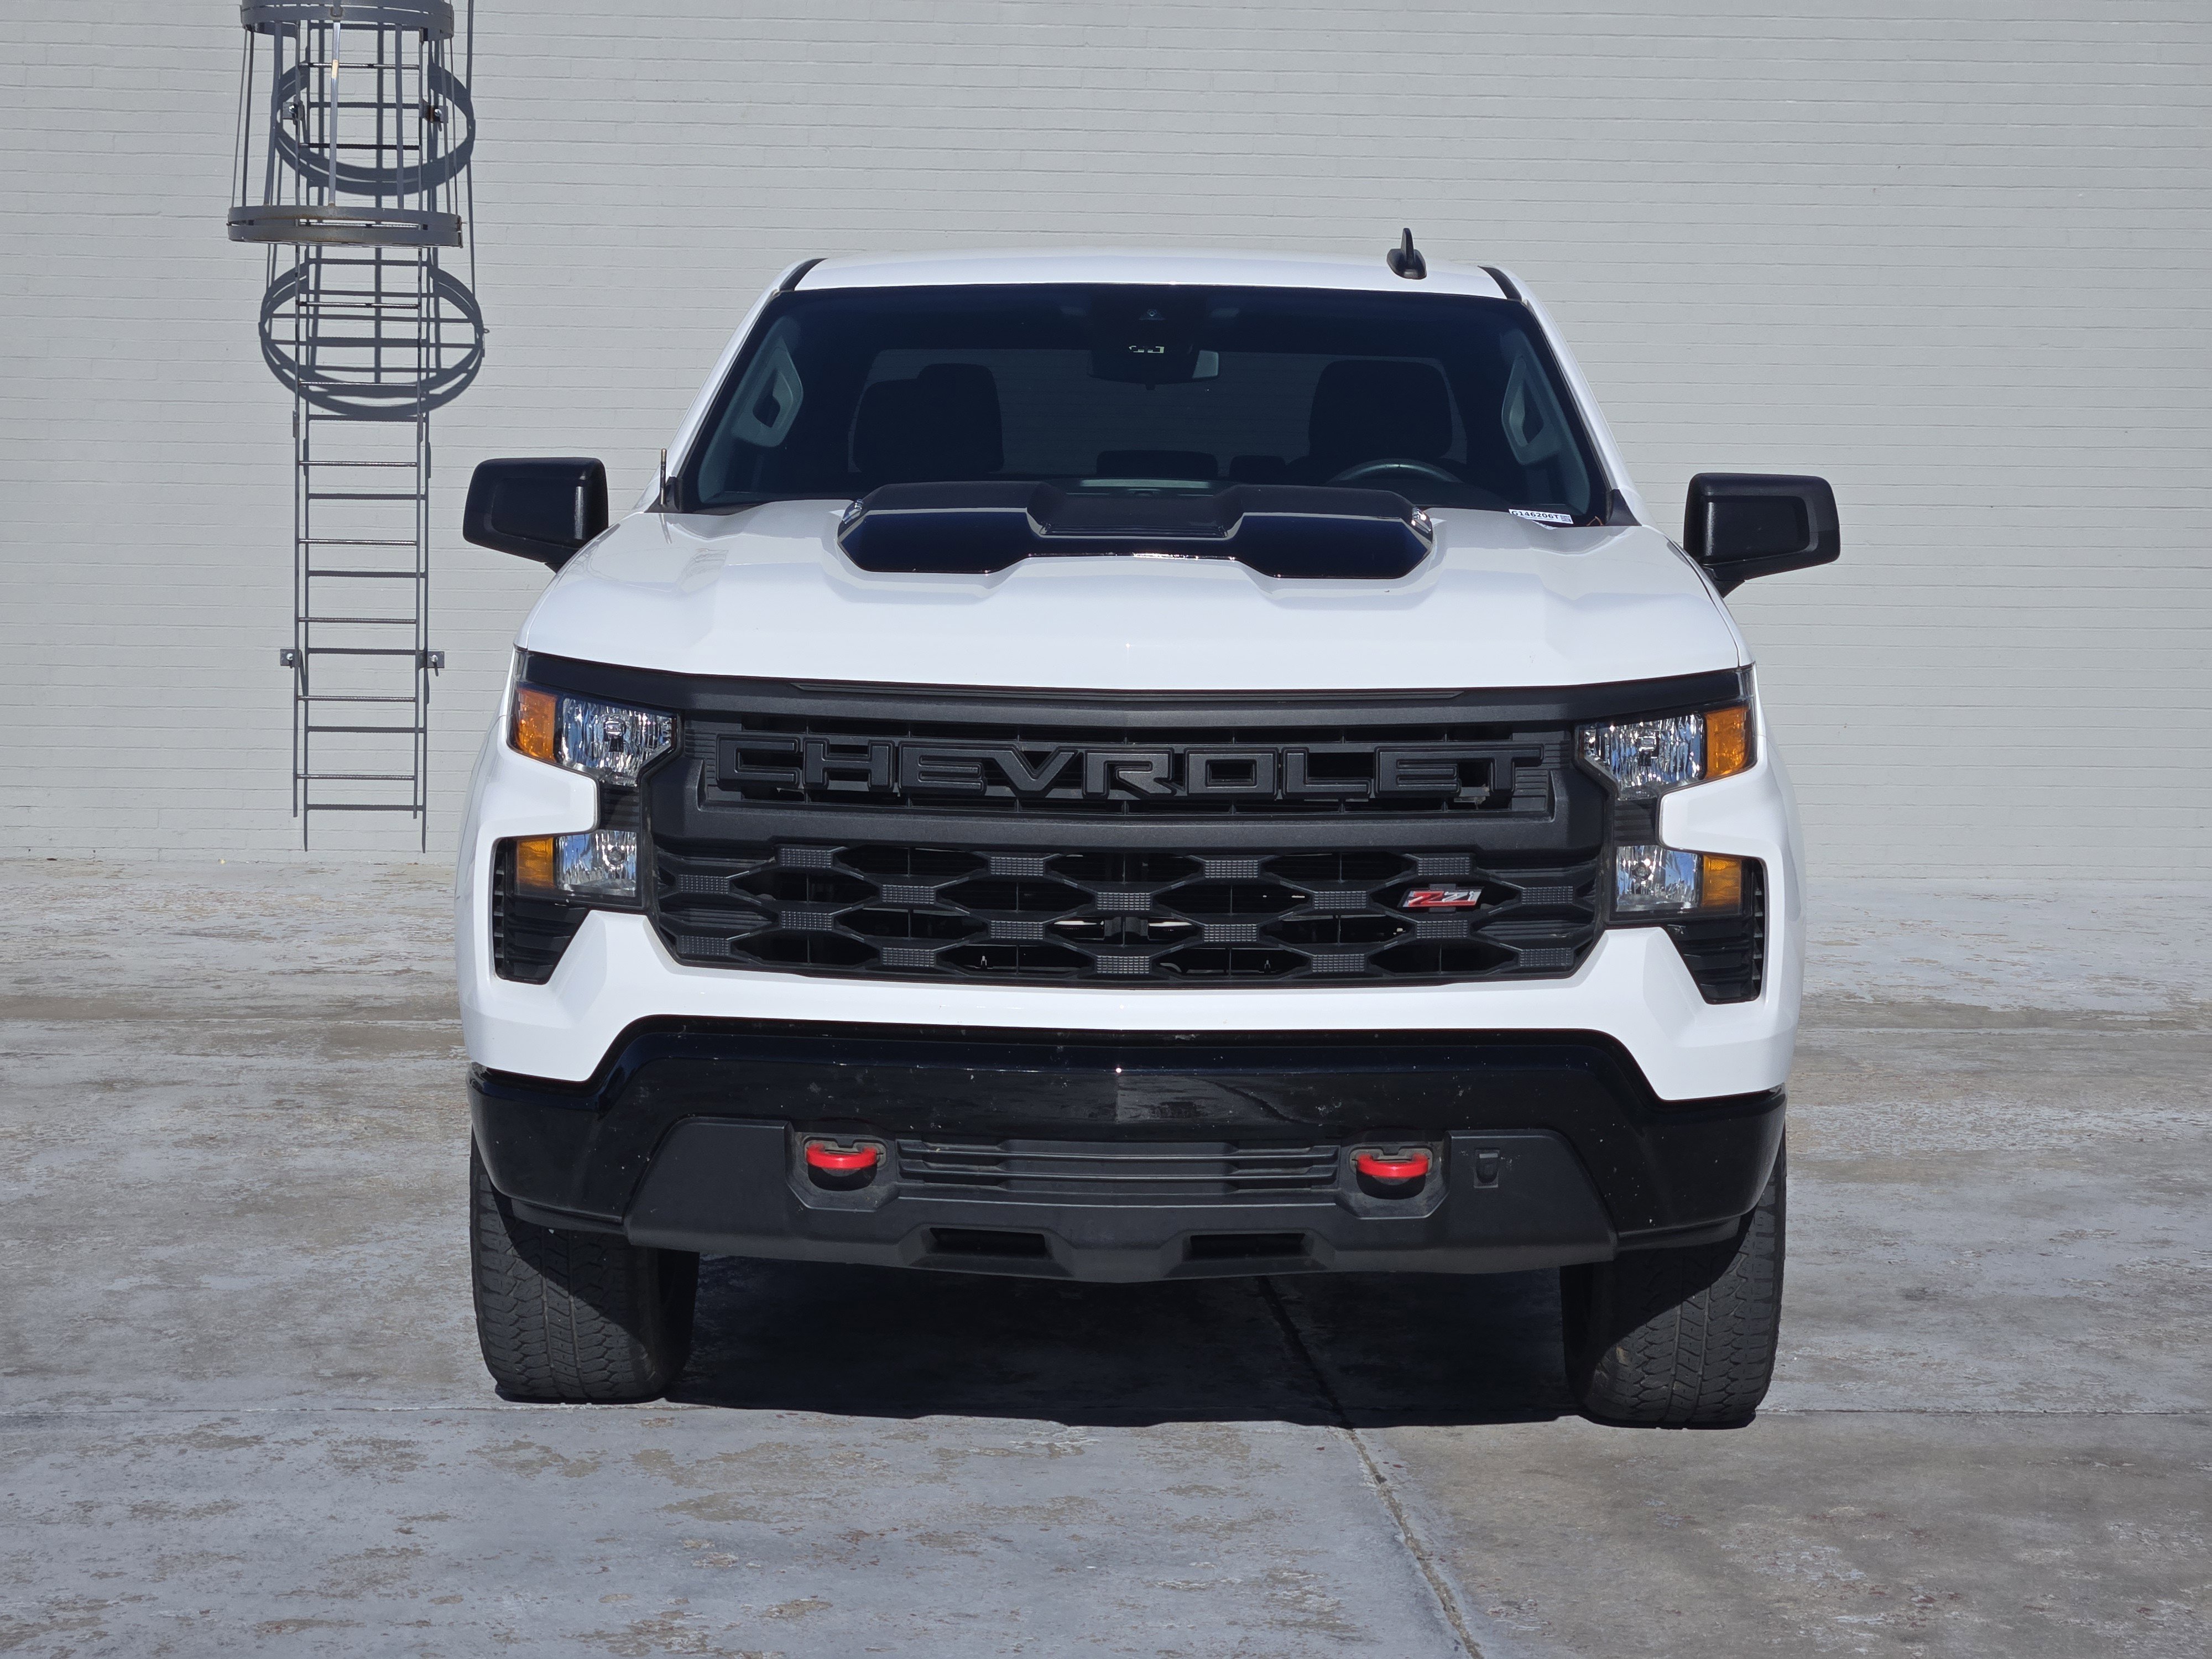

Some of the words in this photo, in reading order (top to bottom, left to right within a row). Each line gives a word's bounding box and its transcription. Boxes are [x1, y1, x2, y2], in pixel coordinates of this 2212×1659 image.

[1511, 510, 1559, 519] G146206T
[717, 734, 1543, 799] CHEVROLET
[1403, 890, 1482, 907] Z71
